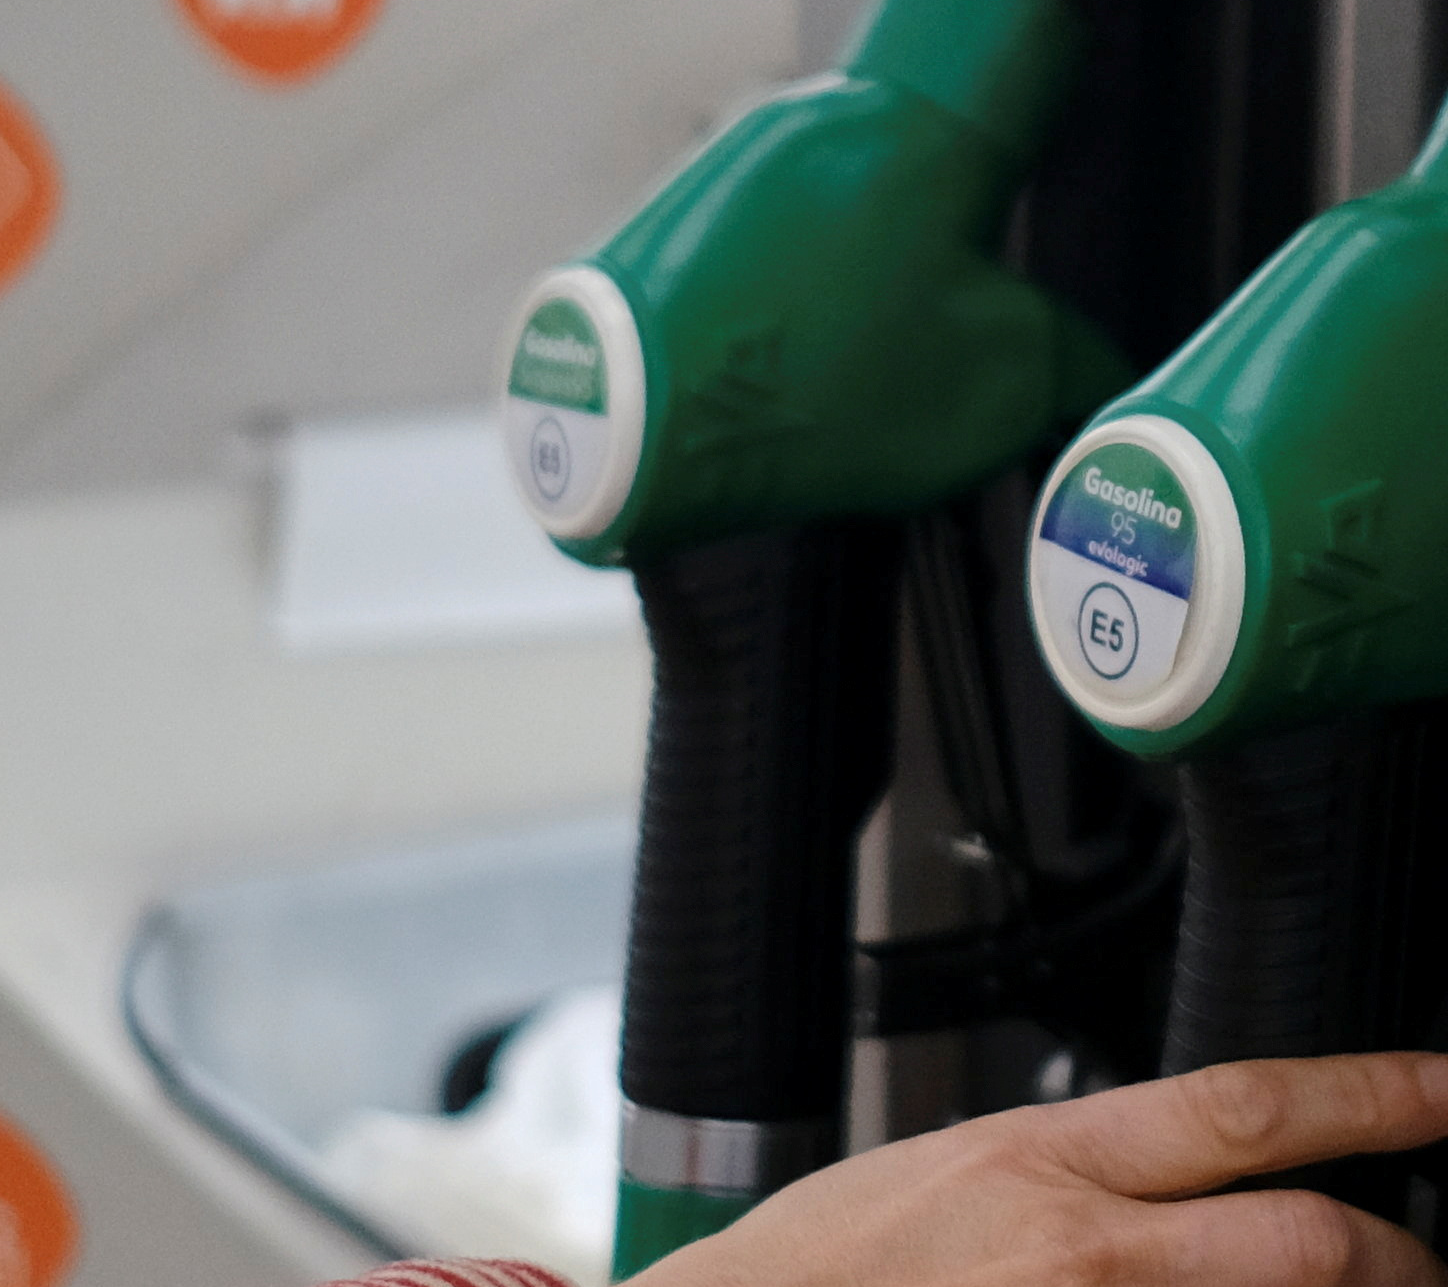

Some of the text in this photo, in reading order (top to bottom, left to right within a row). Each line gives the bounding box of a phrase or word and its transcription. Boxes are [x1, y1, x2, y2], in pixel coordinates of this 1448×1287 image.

[1083, 466, 1183, 530] Gasolina
[1110, 512, 1139, 546] 95
[1088, 538, 1149, 578] evologic
[1090, 608, 1125, 653] E5
